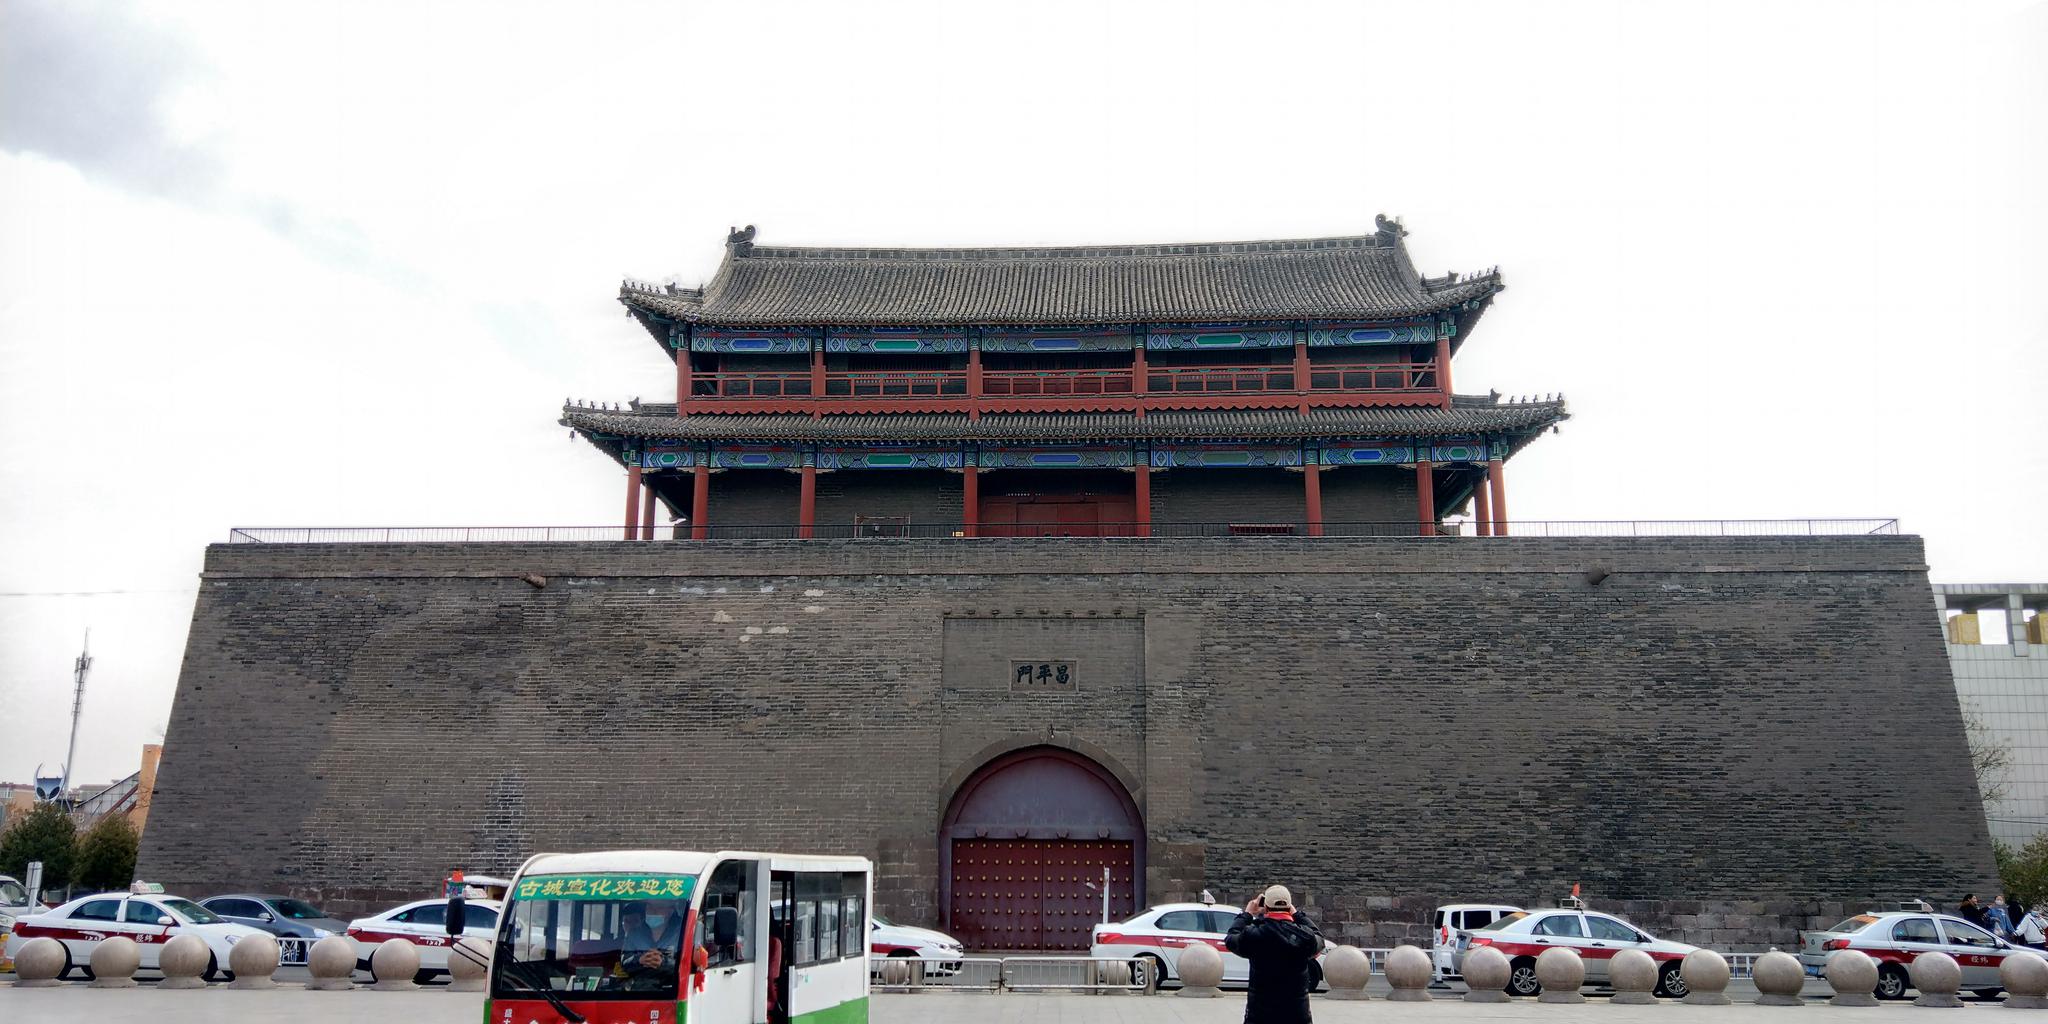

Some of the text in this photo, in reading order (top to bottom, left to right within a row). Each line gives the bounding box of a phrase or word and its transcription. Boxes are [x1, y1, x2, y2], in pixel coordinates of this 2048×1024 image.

[519, 878, 685, 897] 古城宣化欢迎您
